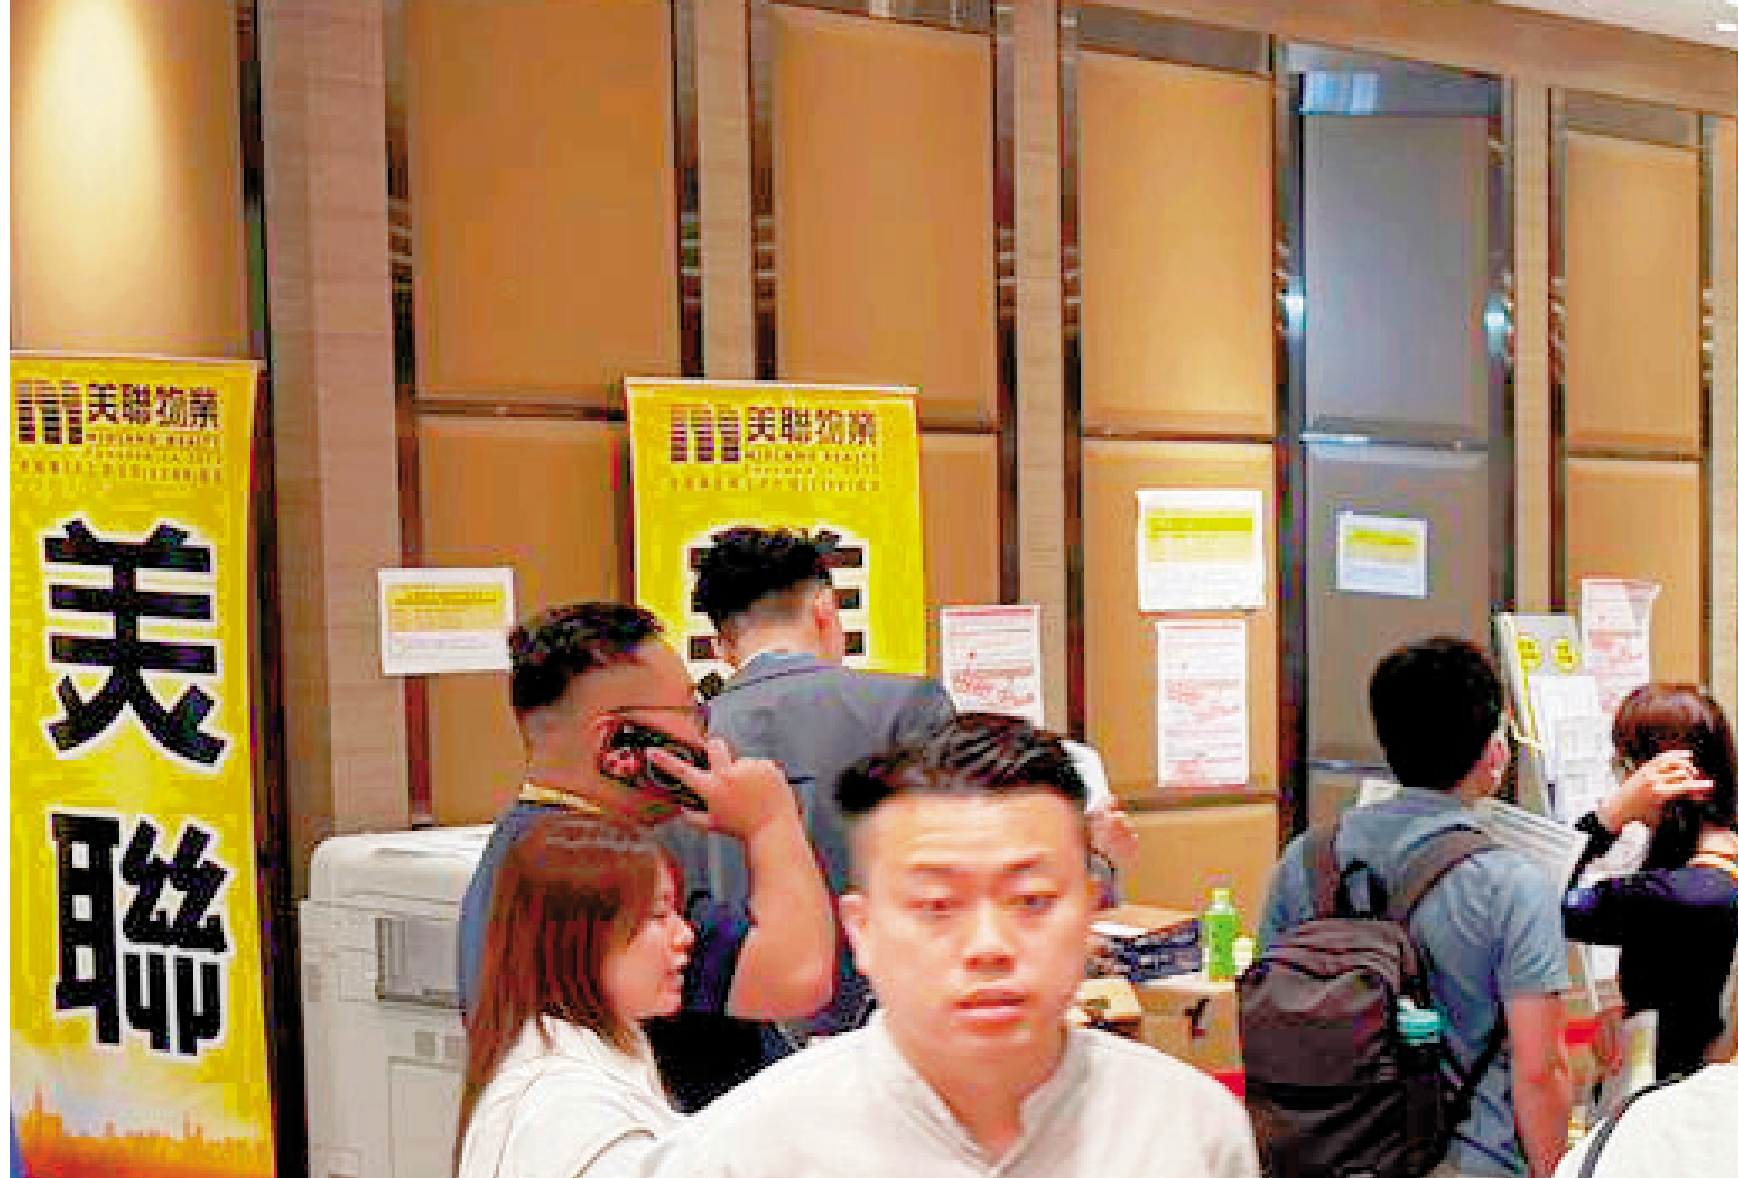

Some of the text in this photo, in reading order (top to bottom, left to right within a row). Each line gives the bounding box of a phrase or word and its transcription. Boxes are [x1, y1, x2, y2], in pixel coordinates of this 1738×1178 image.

[88, 383, 218, 427] 美聯物業
[43, 518, 230, 1057] 美聯
